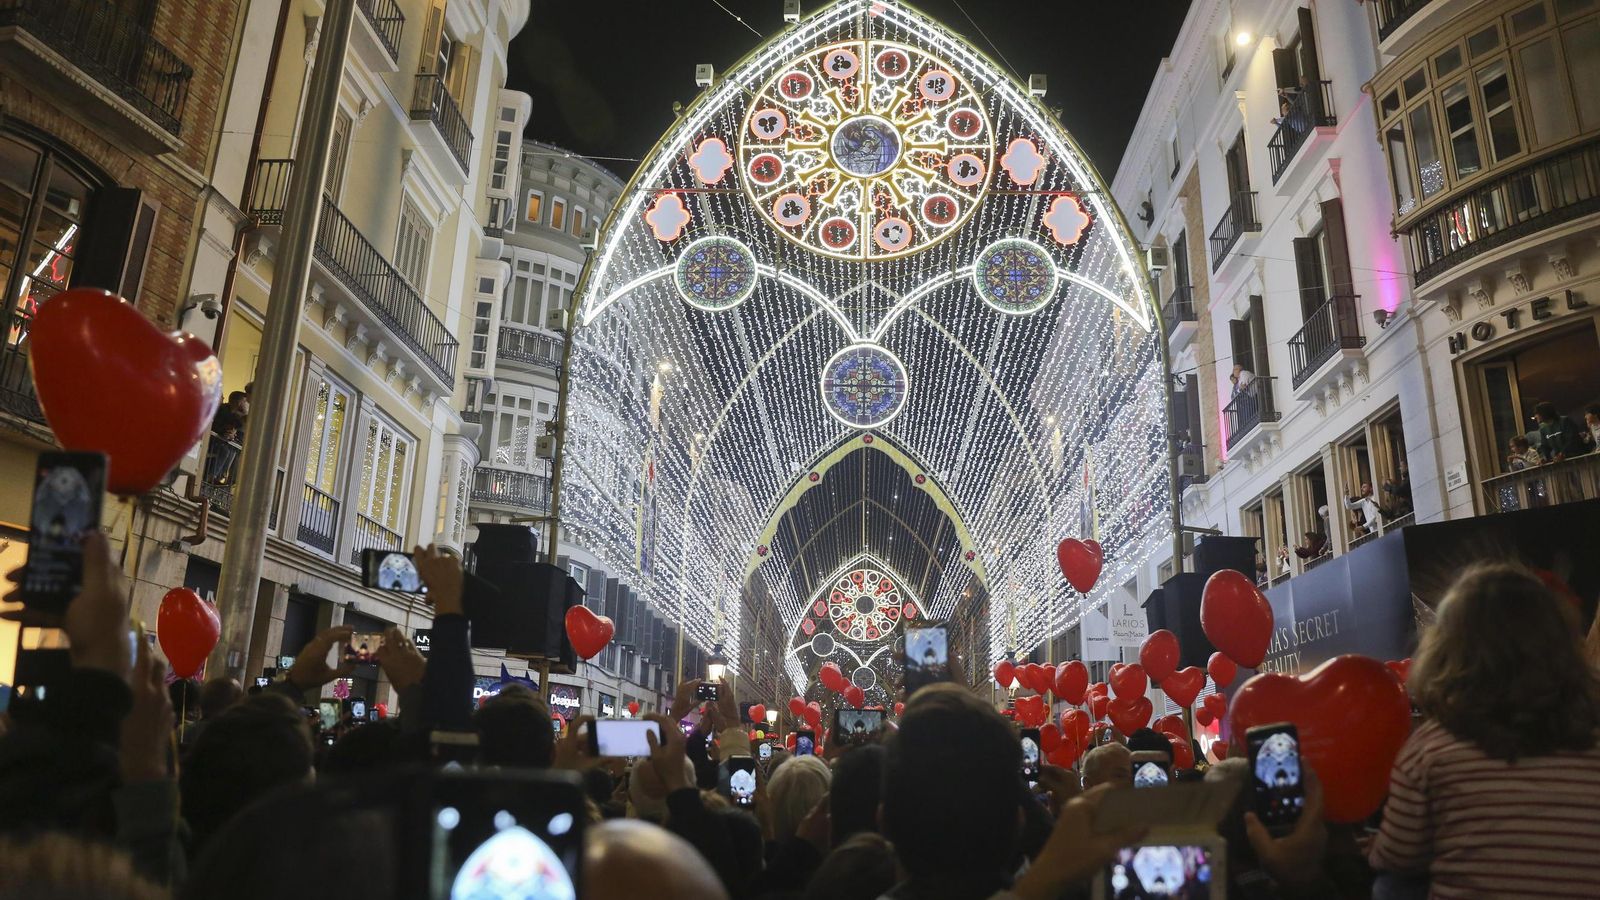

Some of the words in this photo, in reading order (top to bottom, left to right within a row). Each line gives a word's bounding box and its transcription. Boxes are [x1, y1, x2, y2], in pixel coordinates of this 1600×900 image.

[1448, 290, 1588, 354] HOTEL
[1124, 604, 1133, 616] L
[1112, 619, 1145, 629] LARIOS
[1292, 609, 1339, 646] SECRET
